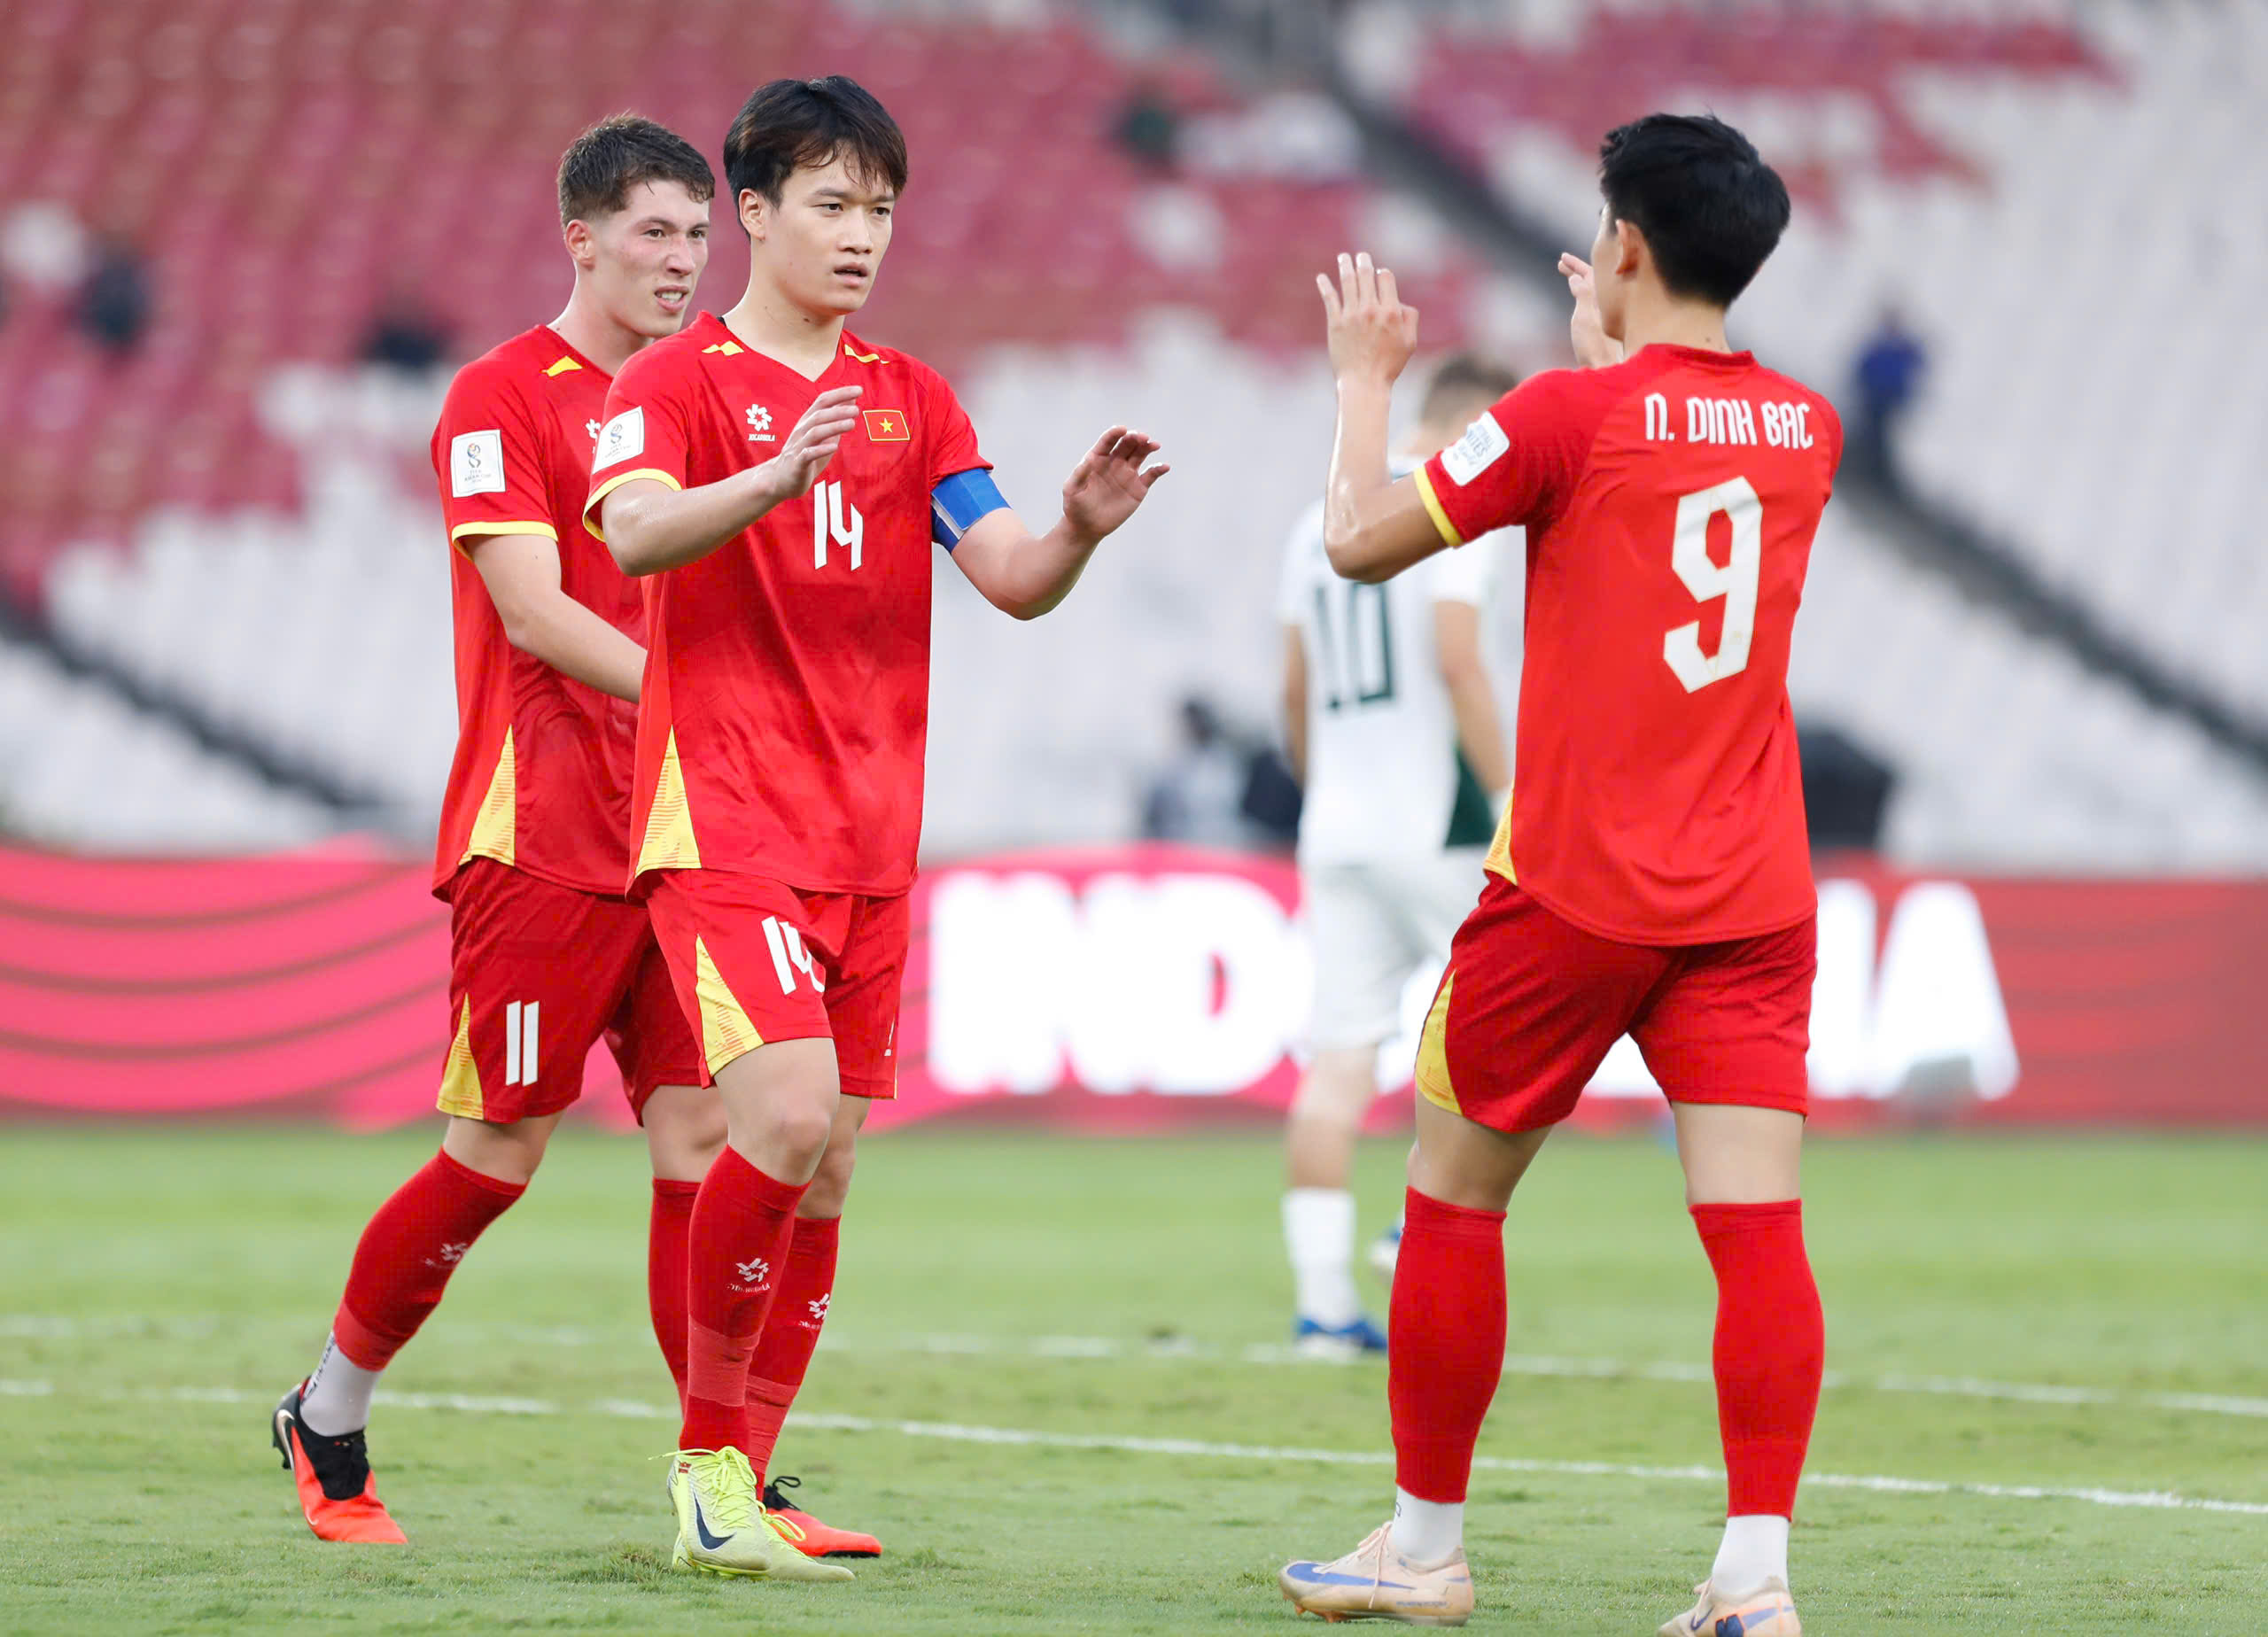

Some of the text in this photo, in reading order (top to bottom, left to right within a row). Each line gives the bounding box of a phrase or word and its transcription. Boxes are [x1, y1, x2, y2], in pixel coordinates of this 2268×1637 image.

[1644, 392, 1814, 449] N. DINH BAC
[814, 480, 864, 571] 14
[1663, 476, 1764, 694] 9
[1314, 580, 1396, 710] 10
[761, 916, 826, 996] 14
[506, 1000, 540, 1087] 11
